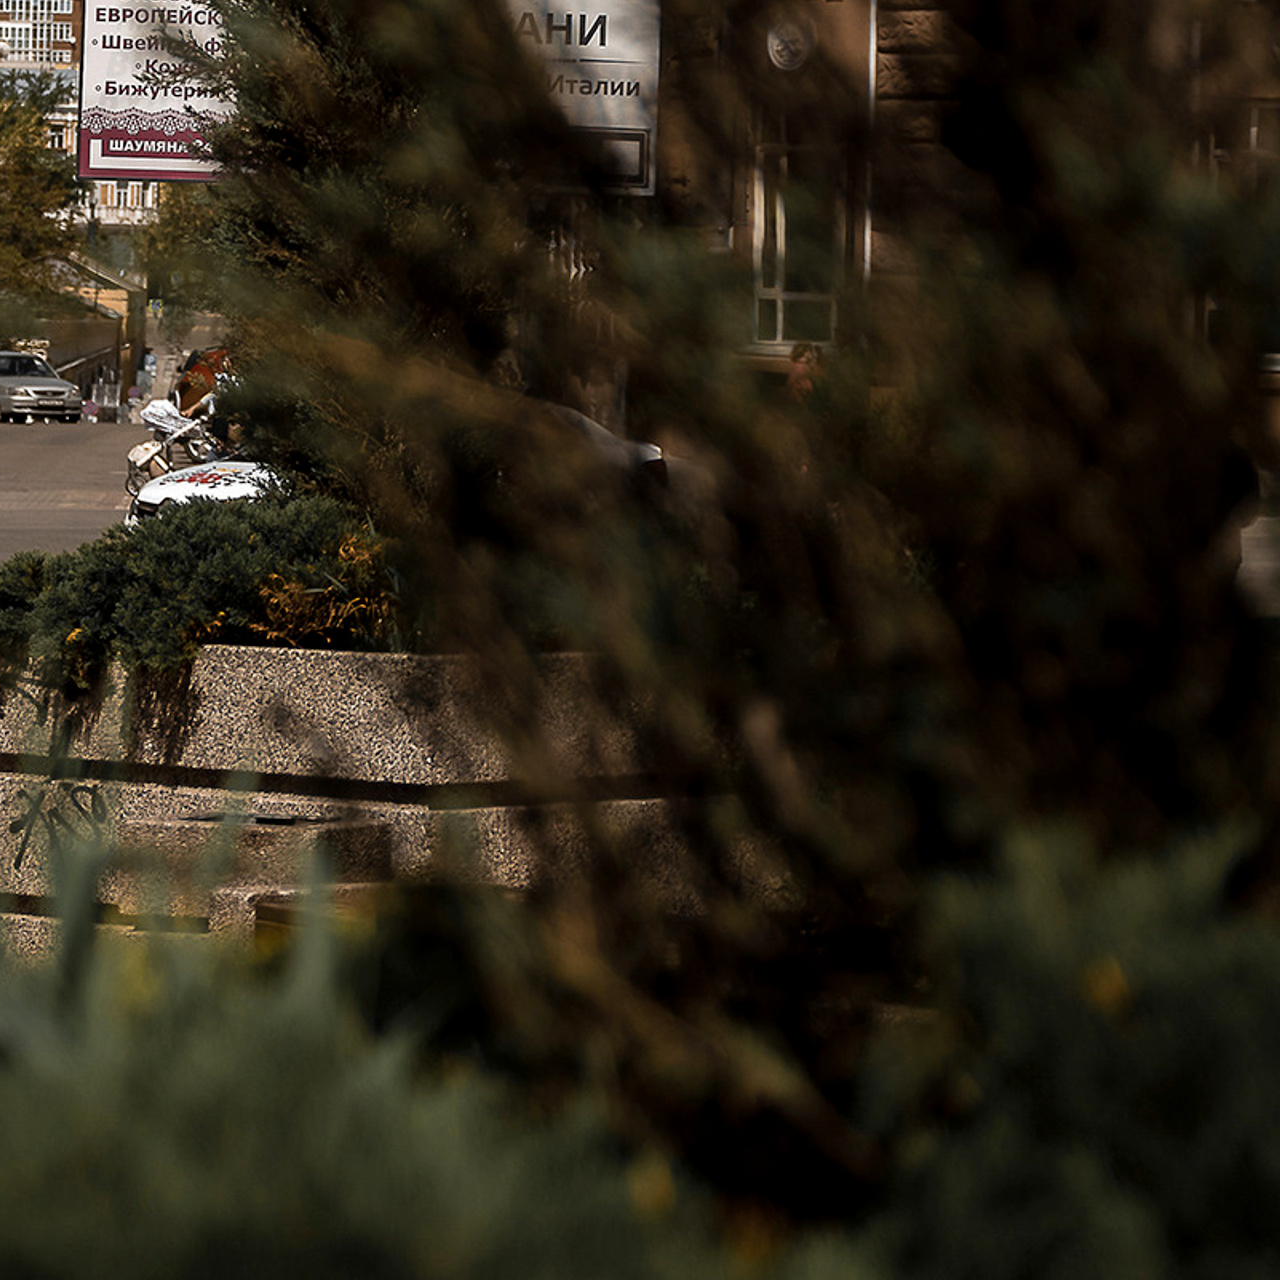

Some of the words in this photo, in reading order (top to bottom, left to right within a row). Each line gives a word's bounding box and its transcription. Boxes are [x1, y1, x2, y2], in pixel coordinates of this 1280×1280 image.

[96, 6, 220, 25] ЕВРОПЕЙСК
[514, 11, 607, 46] АНИ
[548, 74, 640, 97] Италии
